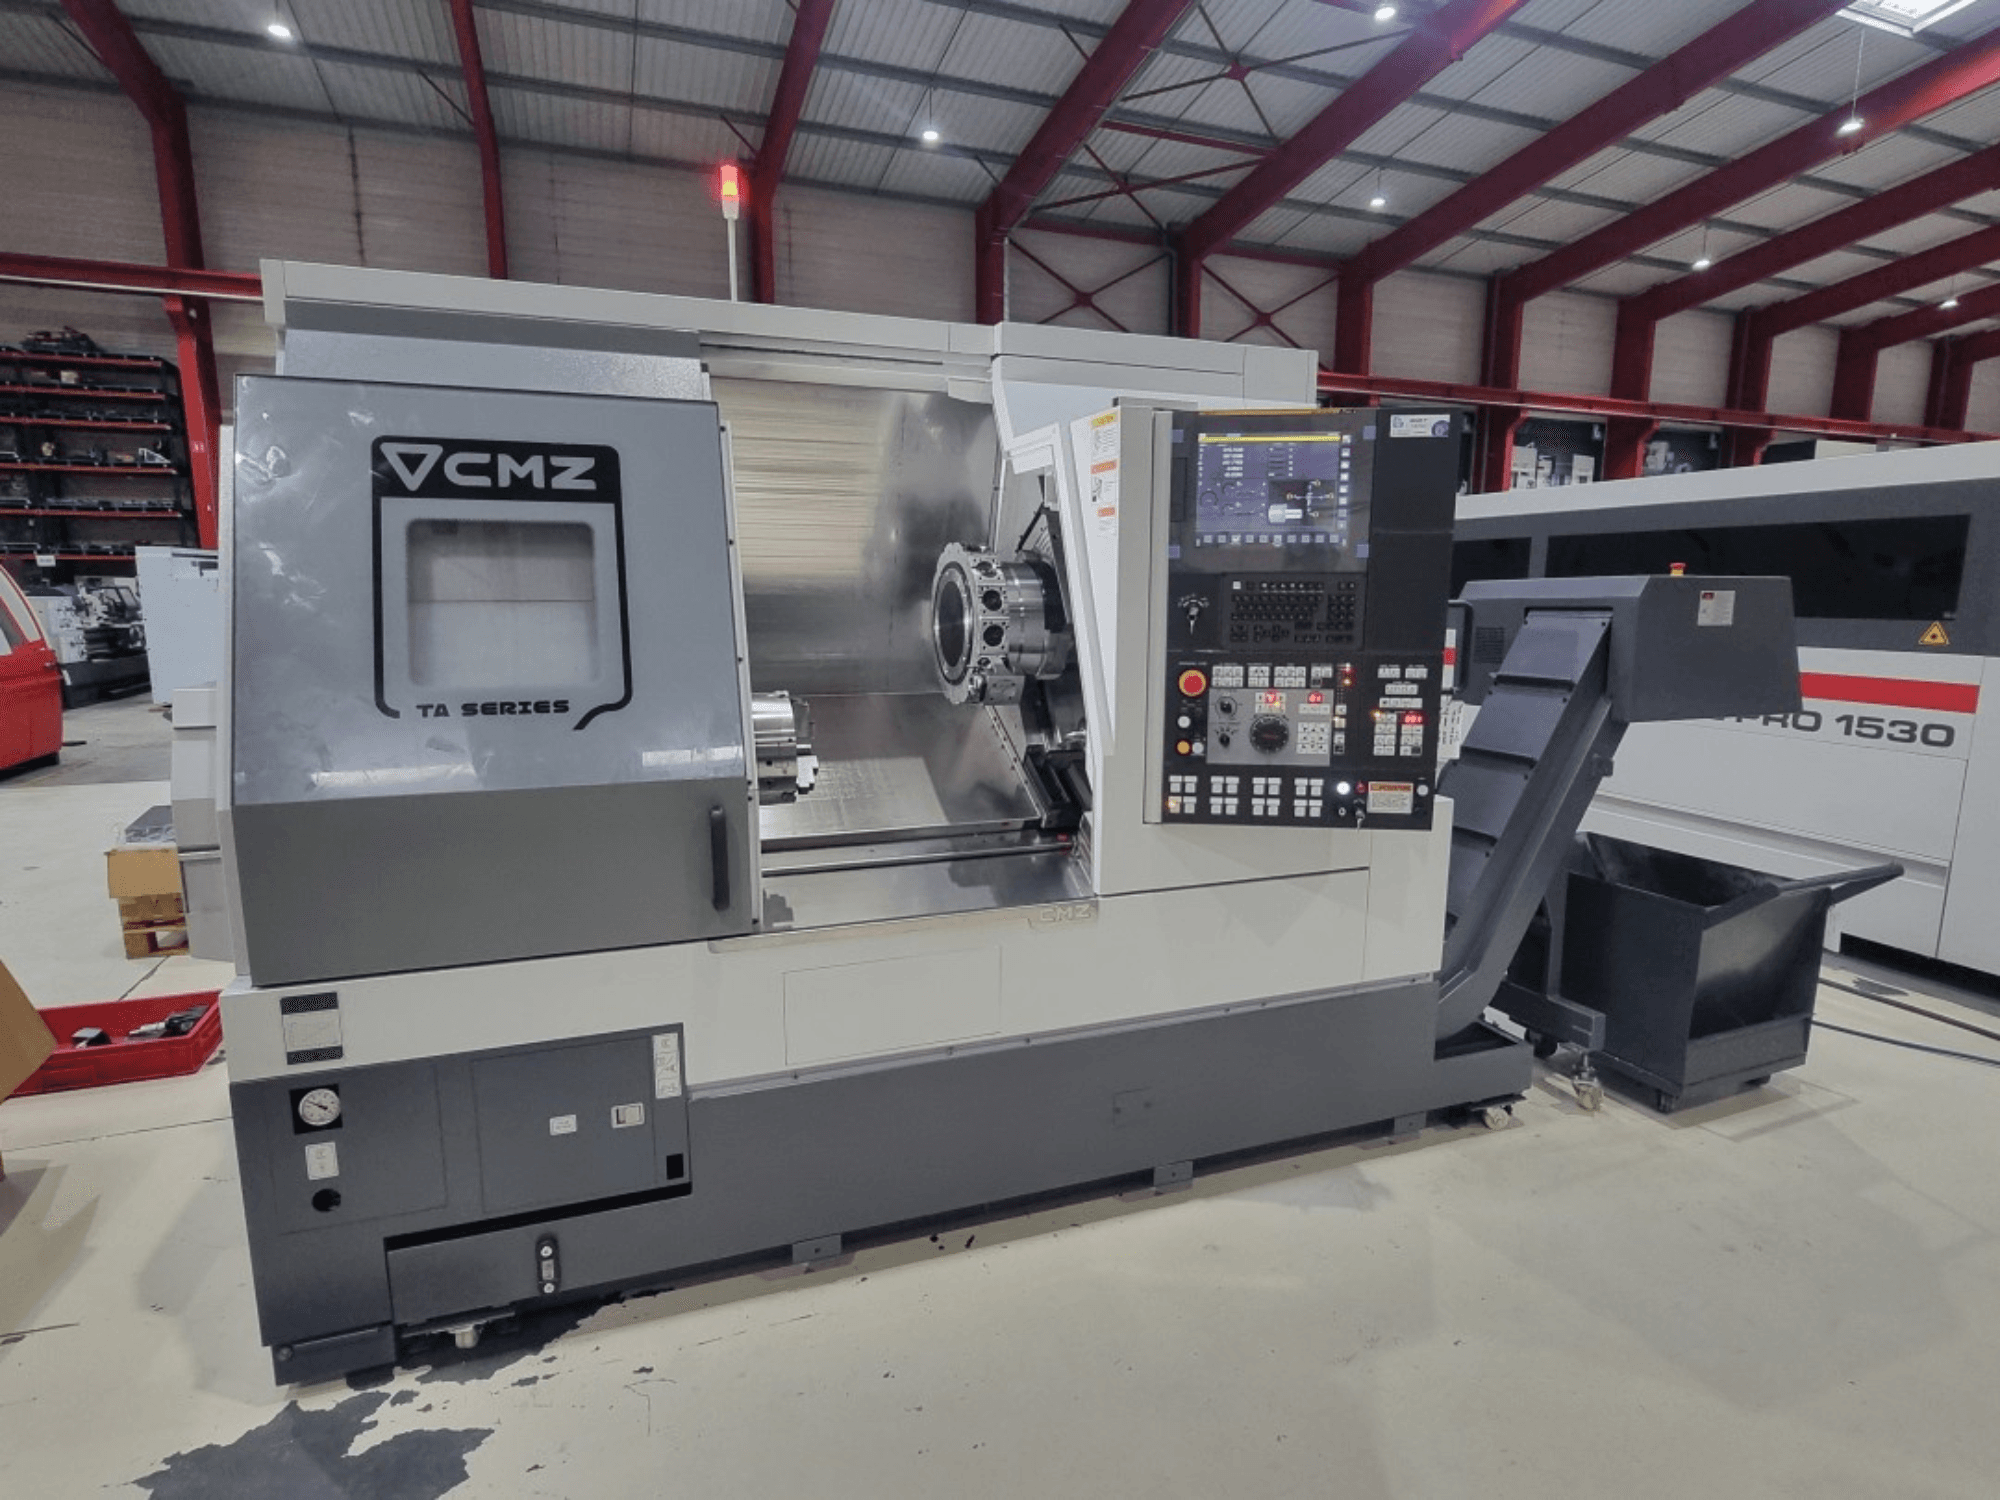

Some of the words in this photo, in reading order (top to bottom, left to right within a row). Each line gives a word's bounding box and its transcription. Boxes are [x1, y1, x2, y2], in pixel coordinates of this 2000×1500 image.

[443, 452, 597, 490] CMZ
[416, 703, 450, 718] TA
[461, 699, 570, 717] SERIES
[1736, 709, 1823, 732] RO
[1835, 713, 1956, 748] 1530
[1040, 903, 1092, 922] CMZ
